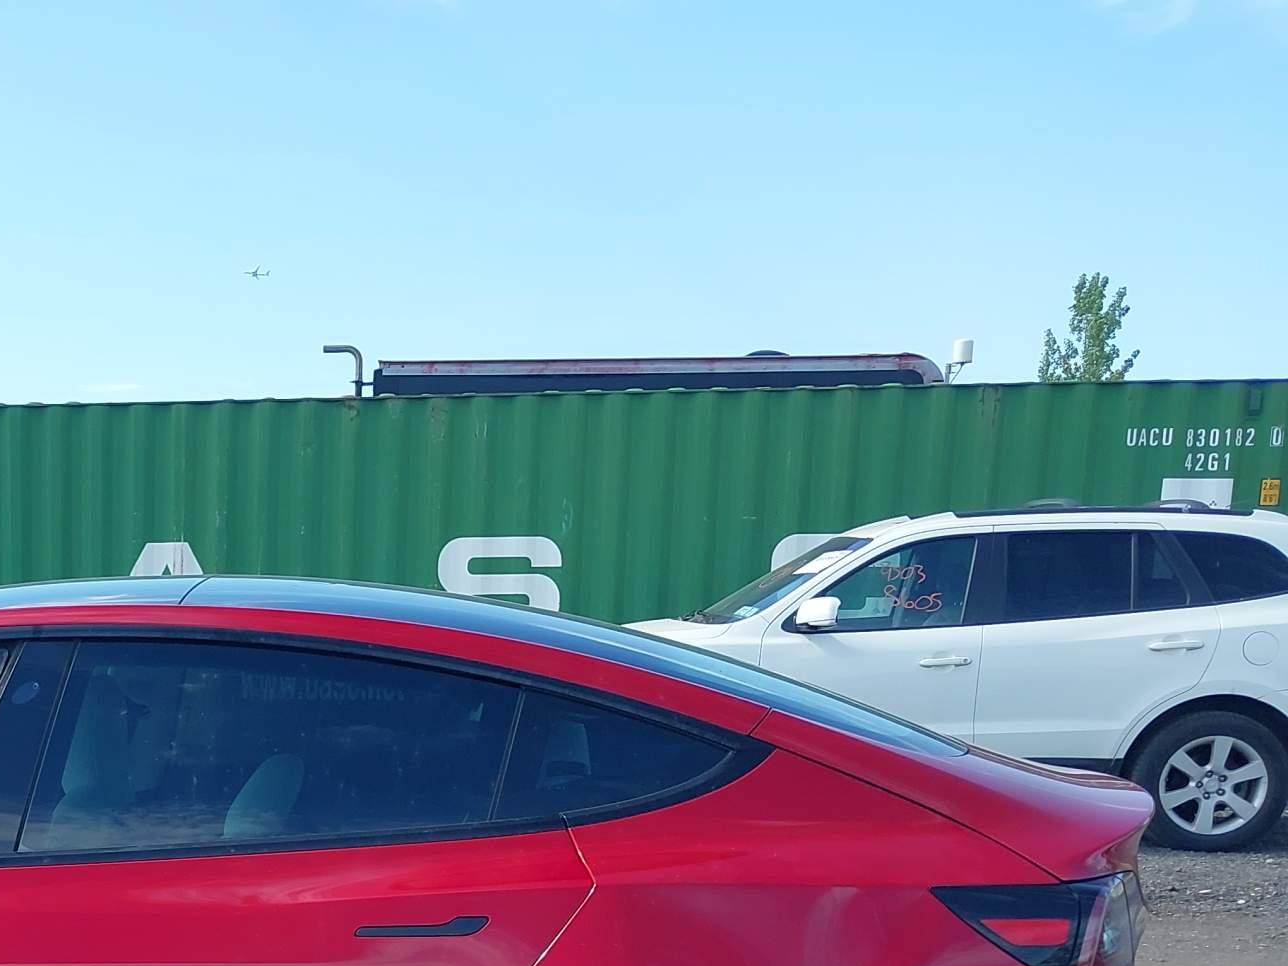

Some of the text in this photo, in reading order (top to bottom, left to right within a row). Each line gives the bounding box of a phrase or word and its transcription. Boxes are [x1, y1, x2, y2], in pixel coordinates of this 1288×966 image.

[1126, 426, 1283, 447] UACU 830182 0
[1184, 452, 1230, 471] 42G1
